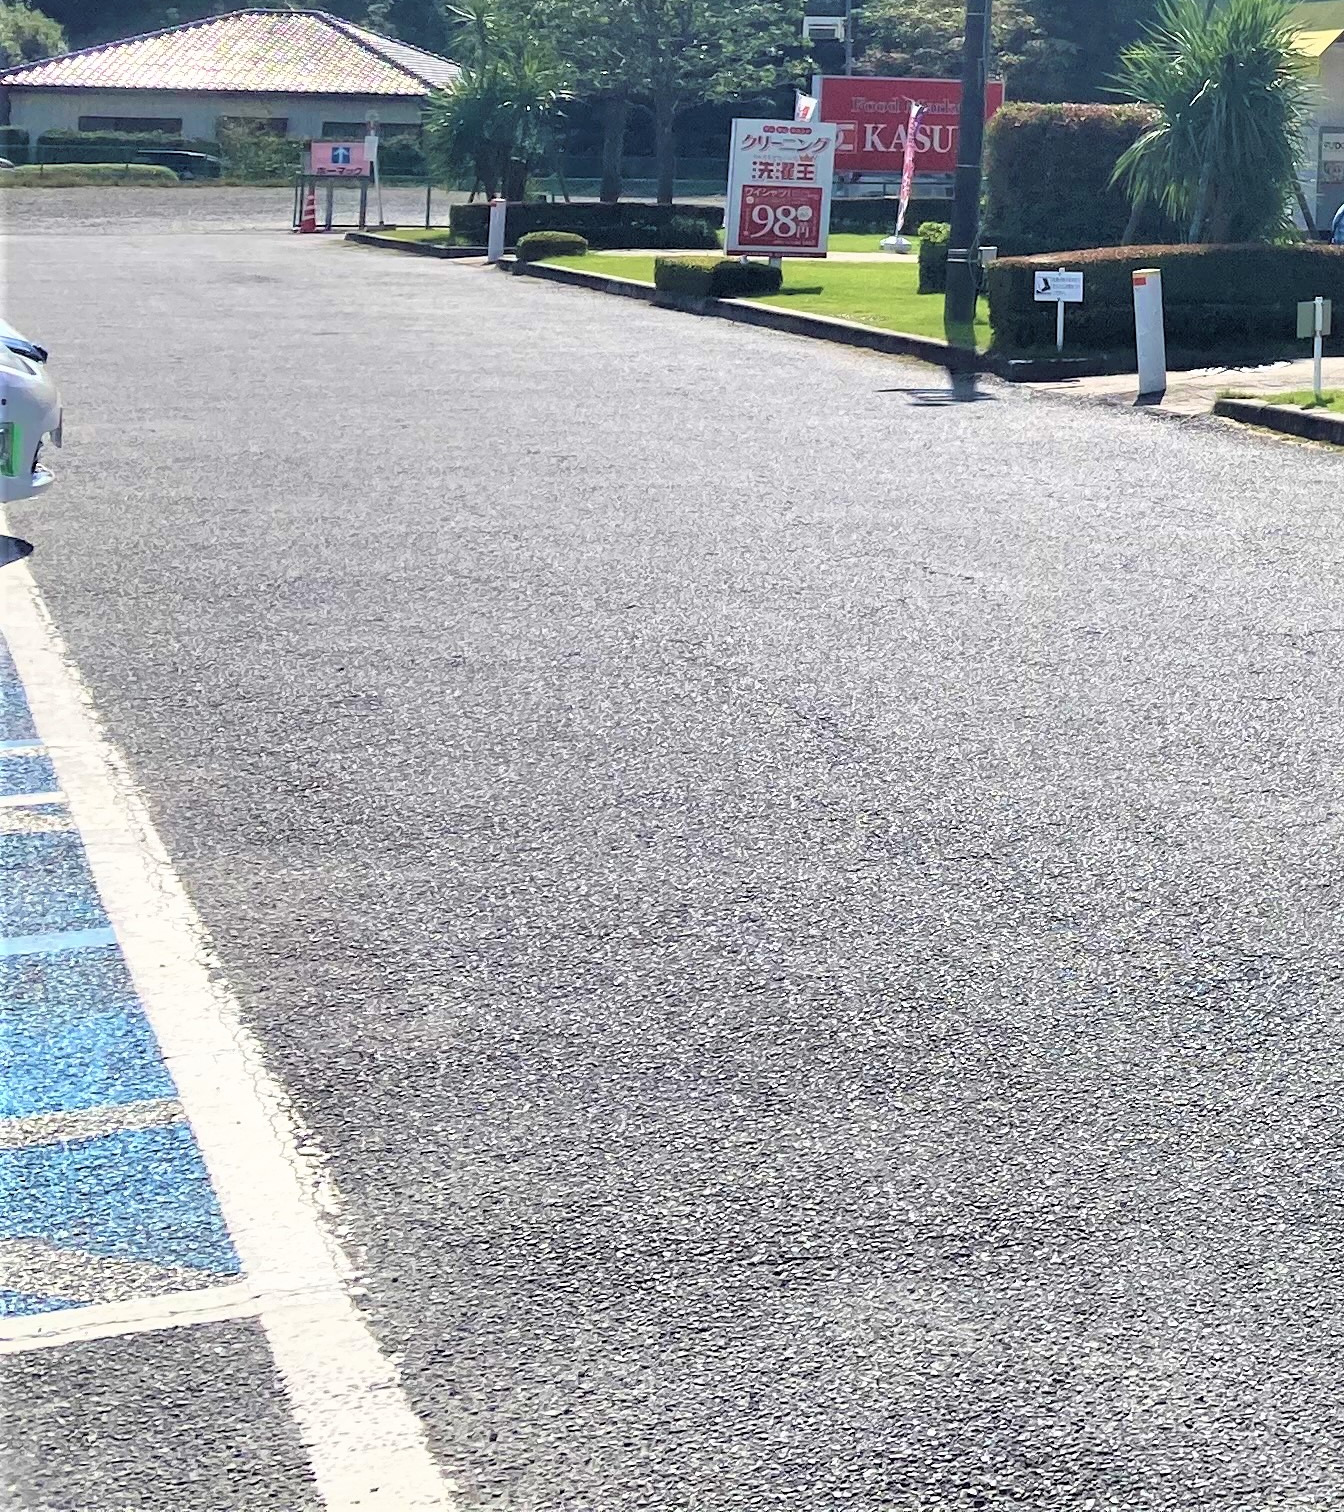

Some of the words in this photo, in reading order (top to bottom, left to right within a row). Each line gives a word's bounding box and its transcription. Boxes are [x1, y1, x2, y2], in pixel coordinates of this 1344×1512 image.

[851, 97, 900, 113] Food
[740, 134, 832, 153] クリーニング
[863, 123, 959, 154] KASU
